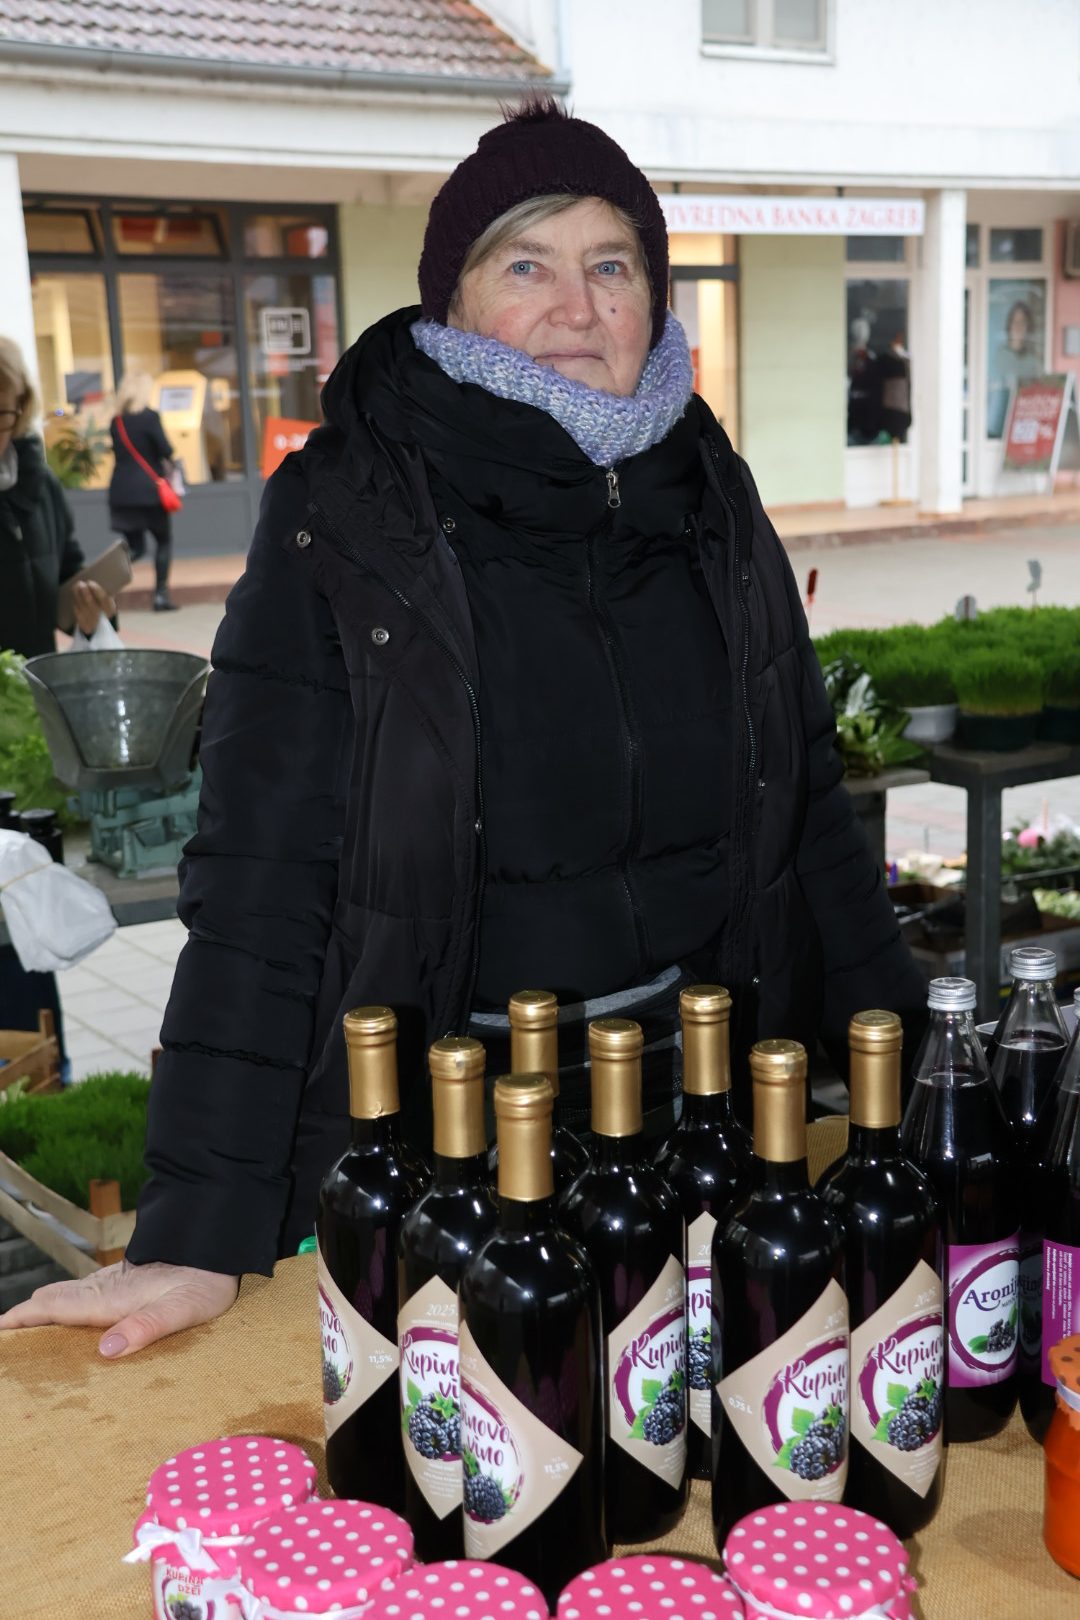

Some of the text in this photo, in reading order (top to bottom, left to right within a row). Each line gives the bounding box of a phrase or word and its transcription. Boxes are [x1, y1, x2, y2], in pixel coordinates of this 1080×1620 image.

[770, 206, 838, 227] BANKA
[846, 207, 919, 229] ZAGREB
[688, 1288, 712, 1318] pi
